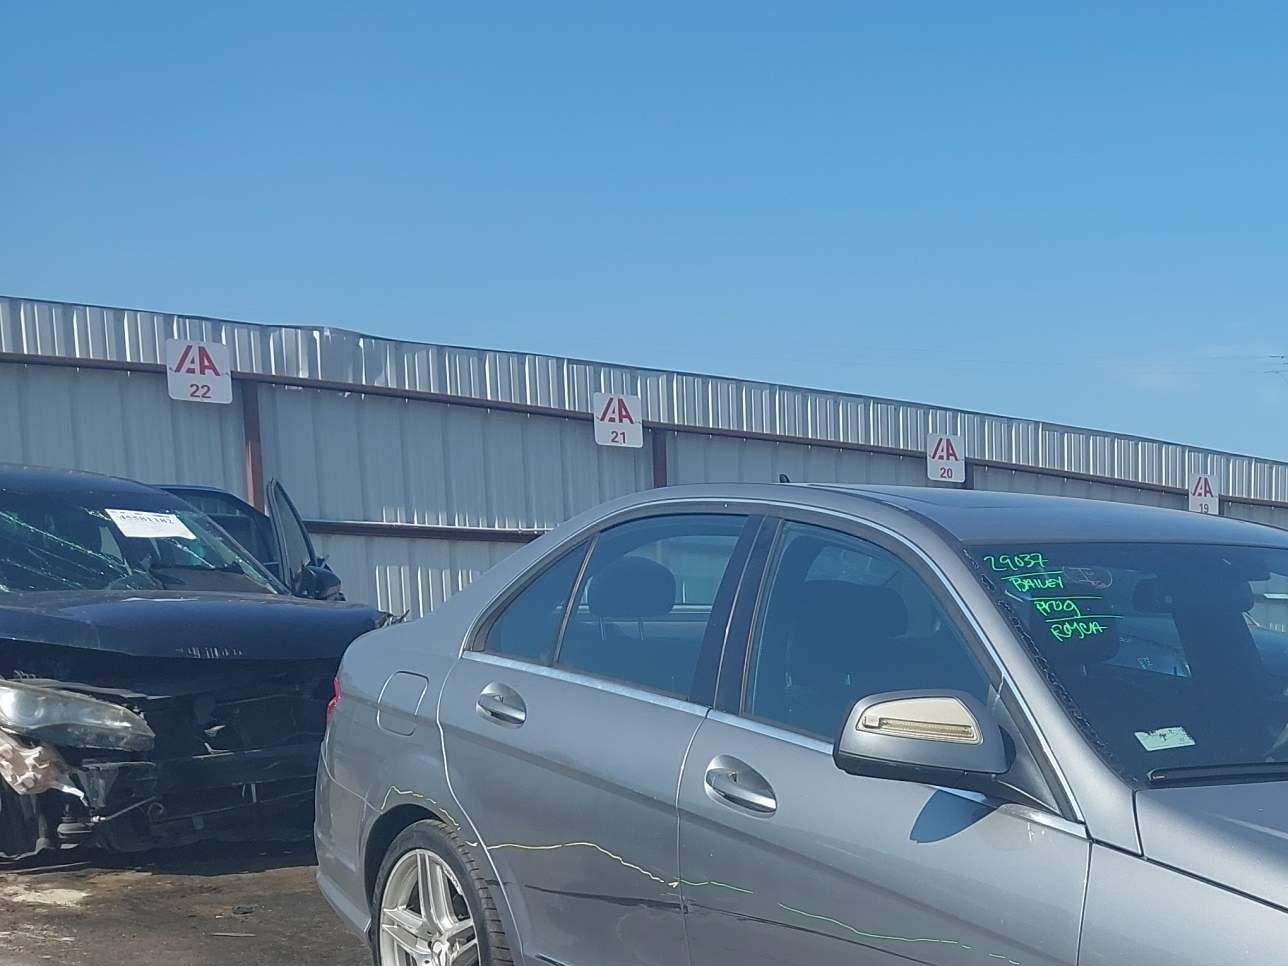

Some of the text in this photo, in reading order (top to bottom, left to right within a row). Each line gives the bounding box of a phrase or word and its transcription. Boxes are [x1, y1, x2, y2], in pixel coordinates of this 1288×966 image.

[189, 383, 212, 399] 22
[610, 430, 626, 444] 21
[940, 467, 953, 479] 20
[1199, 503, 1209, 513] 19
